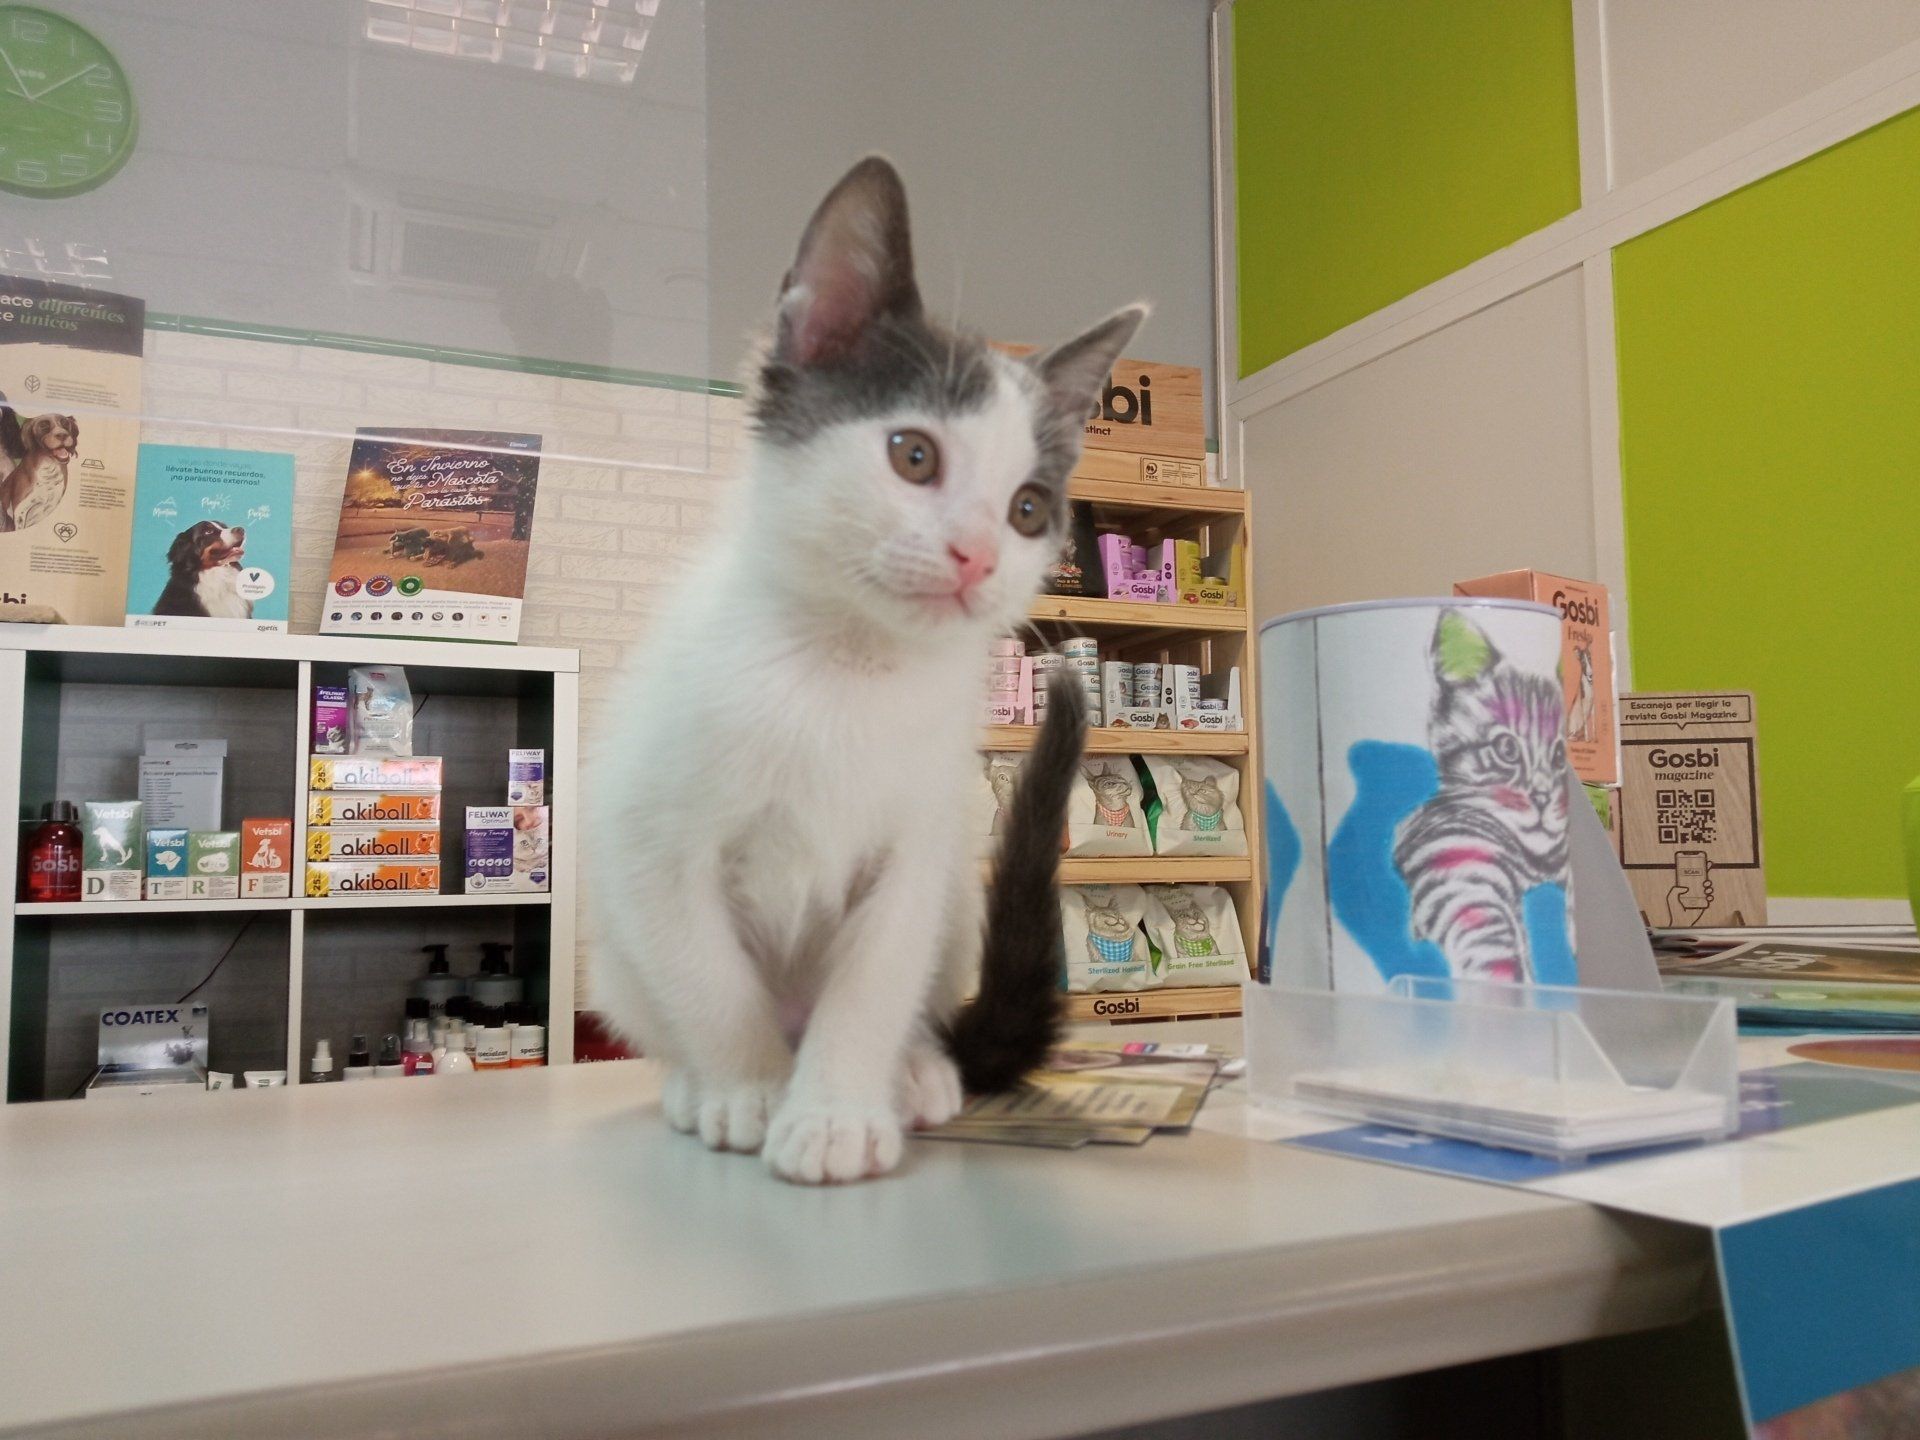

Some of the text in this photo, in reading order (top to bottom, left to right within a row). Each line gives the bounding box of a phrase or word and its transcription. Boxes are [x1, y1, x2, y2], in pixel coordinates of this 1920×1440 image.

[0, 295, 125, 323] ace diferentes
[1088, 375, 1152, 426] bi
[1086, 425, 1111, 435] stinct
[387, 456, 490, 474] En Invierno
[428, 470, 504, 487] Mascota
[403, 492, 492, 510] Parásitos
[1131, 584, 1155, 594] Gosbi
[1200, 590, 1223, 599] Gosbi
[1552, 590, 1599, 627] Gosbi
[1082, 641, 1097, 649] Gosb
[1630, 701, 1672, 710] Escaneja
[1695, 700, 1718, 710] llegir
[991, 707, 1010, 716] osbi
[1130, 713, 1155, 722] Gosbi
[1625, 711, 1737, 720] revista Gosbi Magazine
[1199, 715, 1222, 724] Gosbi
[1648, 747, 1719, 768] Gosbi
[344, 766, 413, 784] akiball
[1654, 770, 1714, 782] magazine
[93, 808, 133, 819] Vetsbi
[342, 802, 410, 820] akiball
[468, 811, 509, 819] FELIWAY
[252, 827, 282, 836] Vetsbi
[1106, 830, 1128, 839] Urinary
[153, 839, 185, 847] Vetsbi
[198, 840, 231, 849] Vetsbi
[341, 837, 408, 855] akiball
[32, 855, 79, 872] Gosb
[86, 877, 105, 895] D
[192, 880, 205, 894] R
[248, 879, 259, 892] F
[340, 872, 408, 890] akiball
[151, 882, 162, 894] T
[1088, 966, 1120, 975] Sterilized
[1168, 962, 1185, 970] Grain
[1205, 959, 1234, 968] Sterilized
[1094, 998, 1140, 1015] Gosbi
[101, 1009, 179, 1026] COATEX
